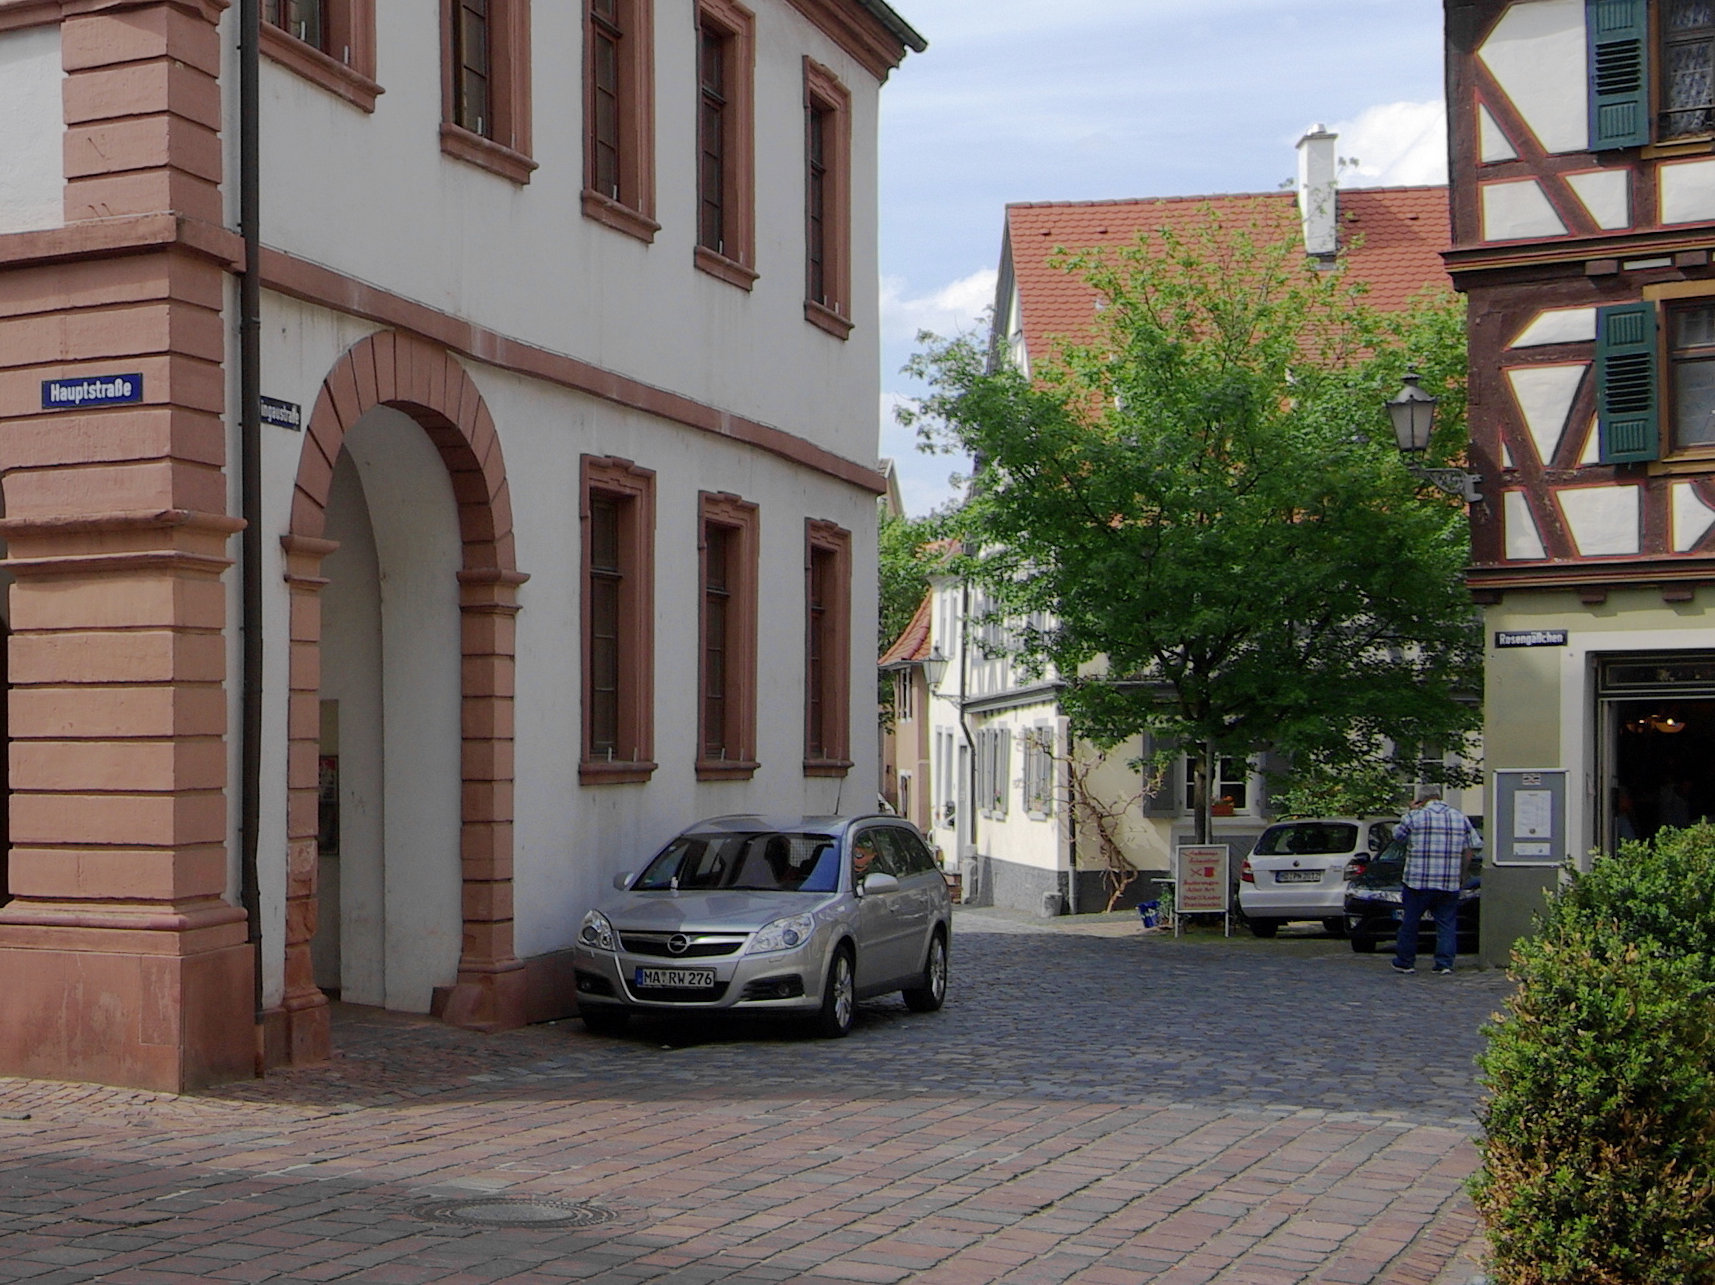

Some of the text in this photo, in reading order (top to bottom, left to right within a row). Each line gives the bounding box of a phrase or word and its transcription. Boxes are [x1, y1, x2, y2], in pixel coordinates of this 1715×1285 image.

[50, 378, 132, 405] Hauptstraße
[1499, 632, 1564, 646] Rosengäßchen
[644, 971, 713, 985] MA RW 276
